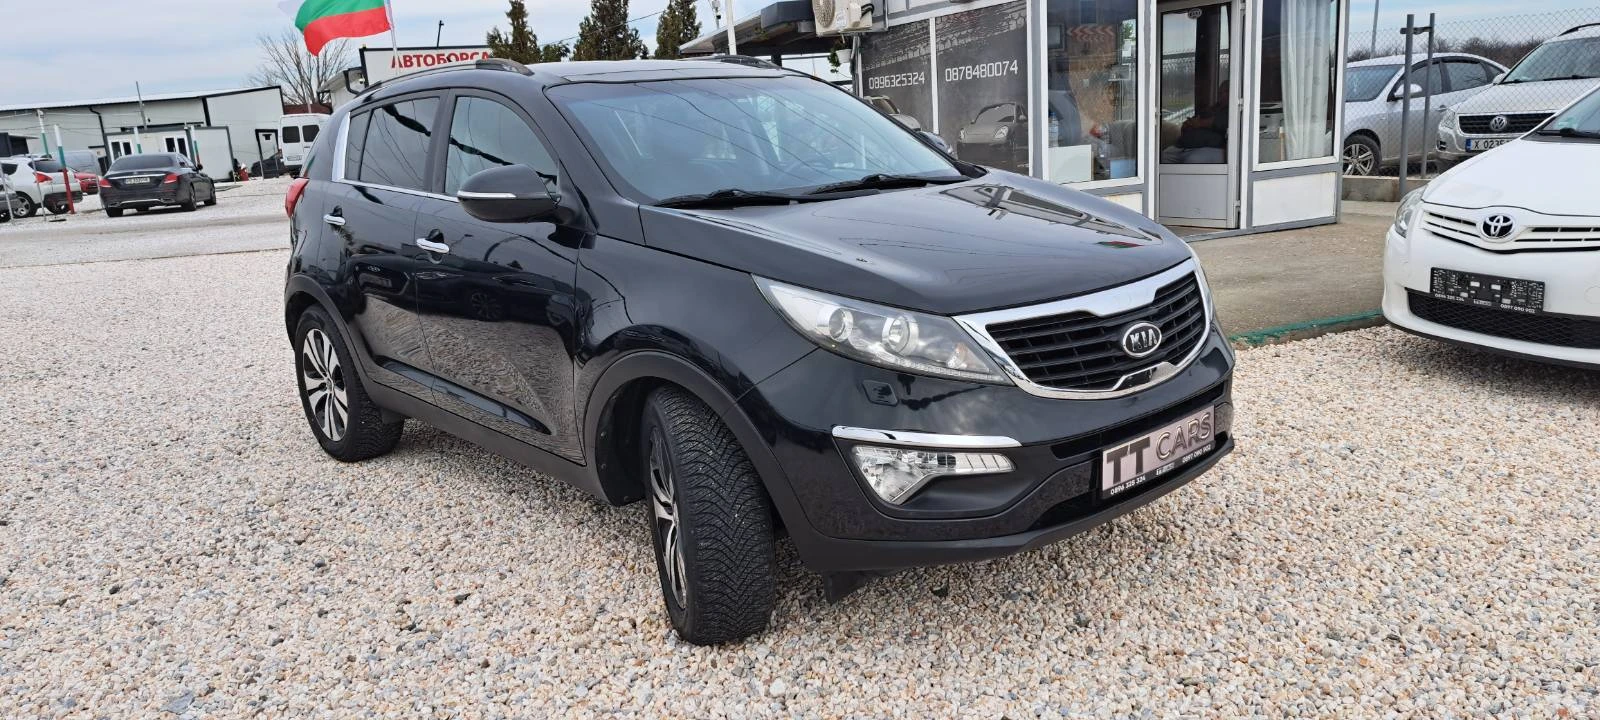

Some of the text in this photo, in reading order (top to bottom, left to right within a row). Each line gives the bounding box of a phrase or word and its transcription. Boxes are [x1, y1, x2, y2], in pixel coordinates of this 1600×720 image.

[868, 71, 925, 90] 0896325324
[945, 59, 1019, 82] 0878480074
[1129, 328, 1158, 352] KIA
[1106, 411, 1212, 485] TT CARS
[1110, 484, 1125, 495] 0896
